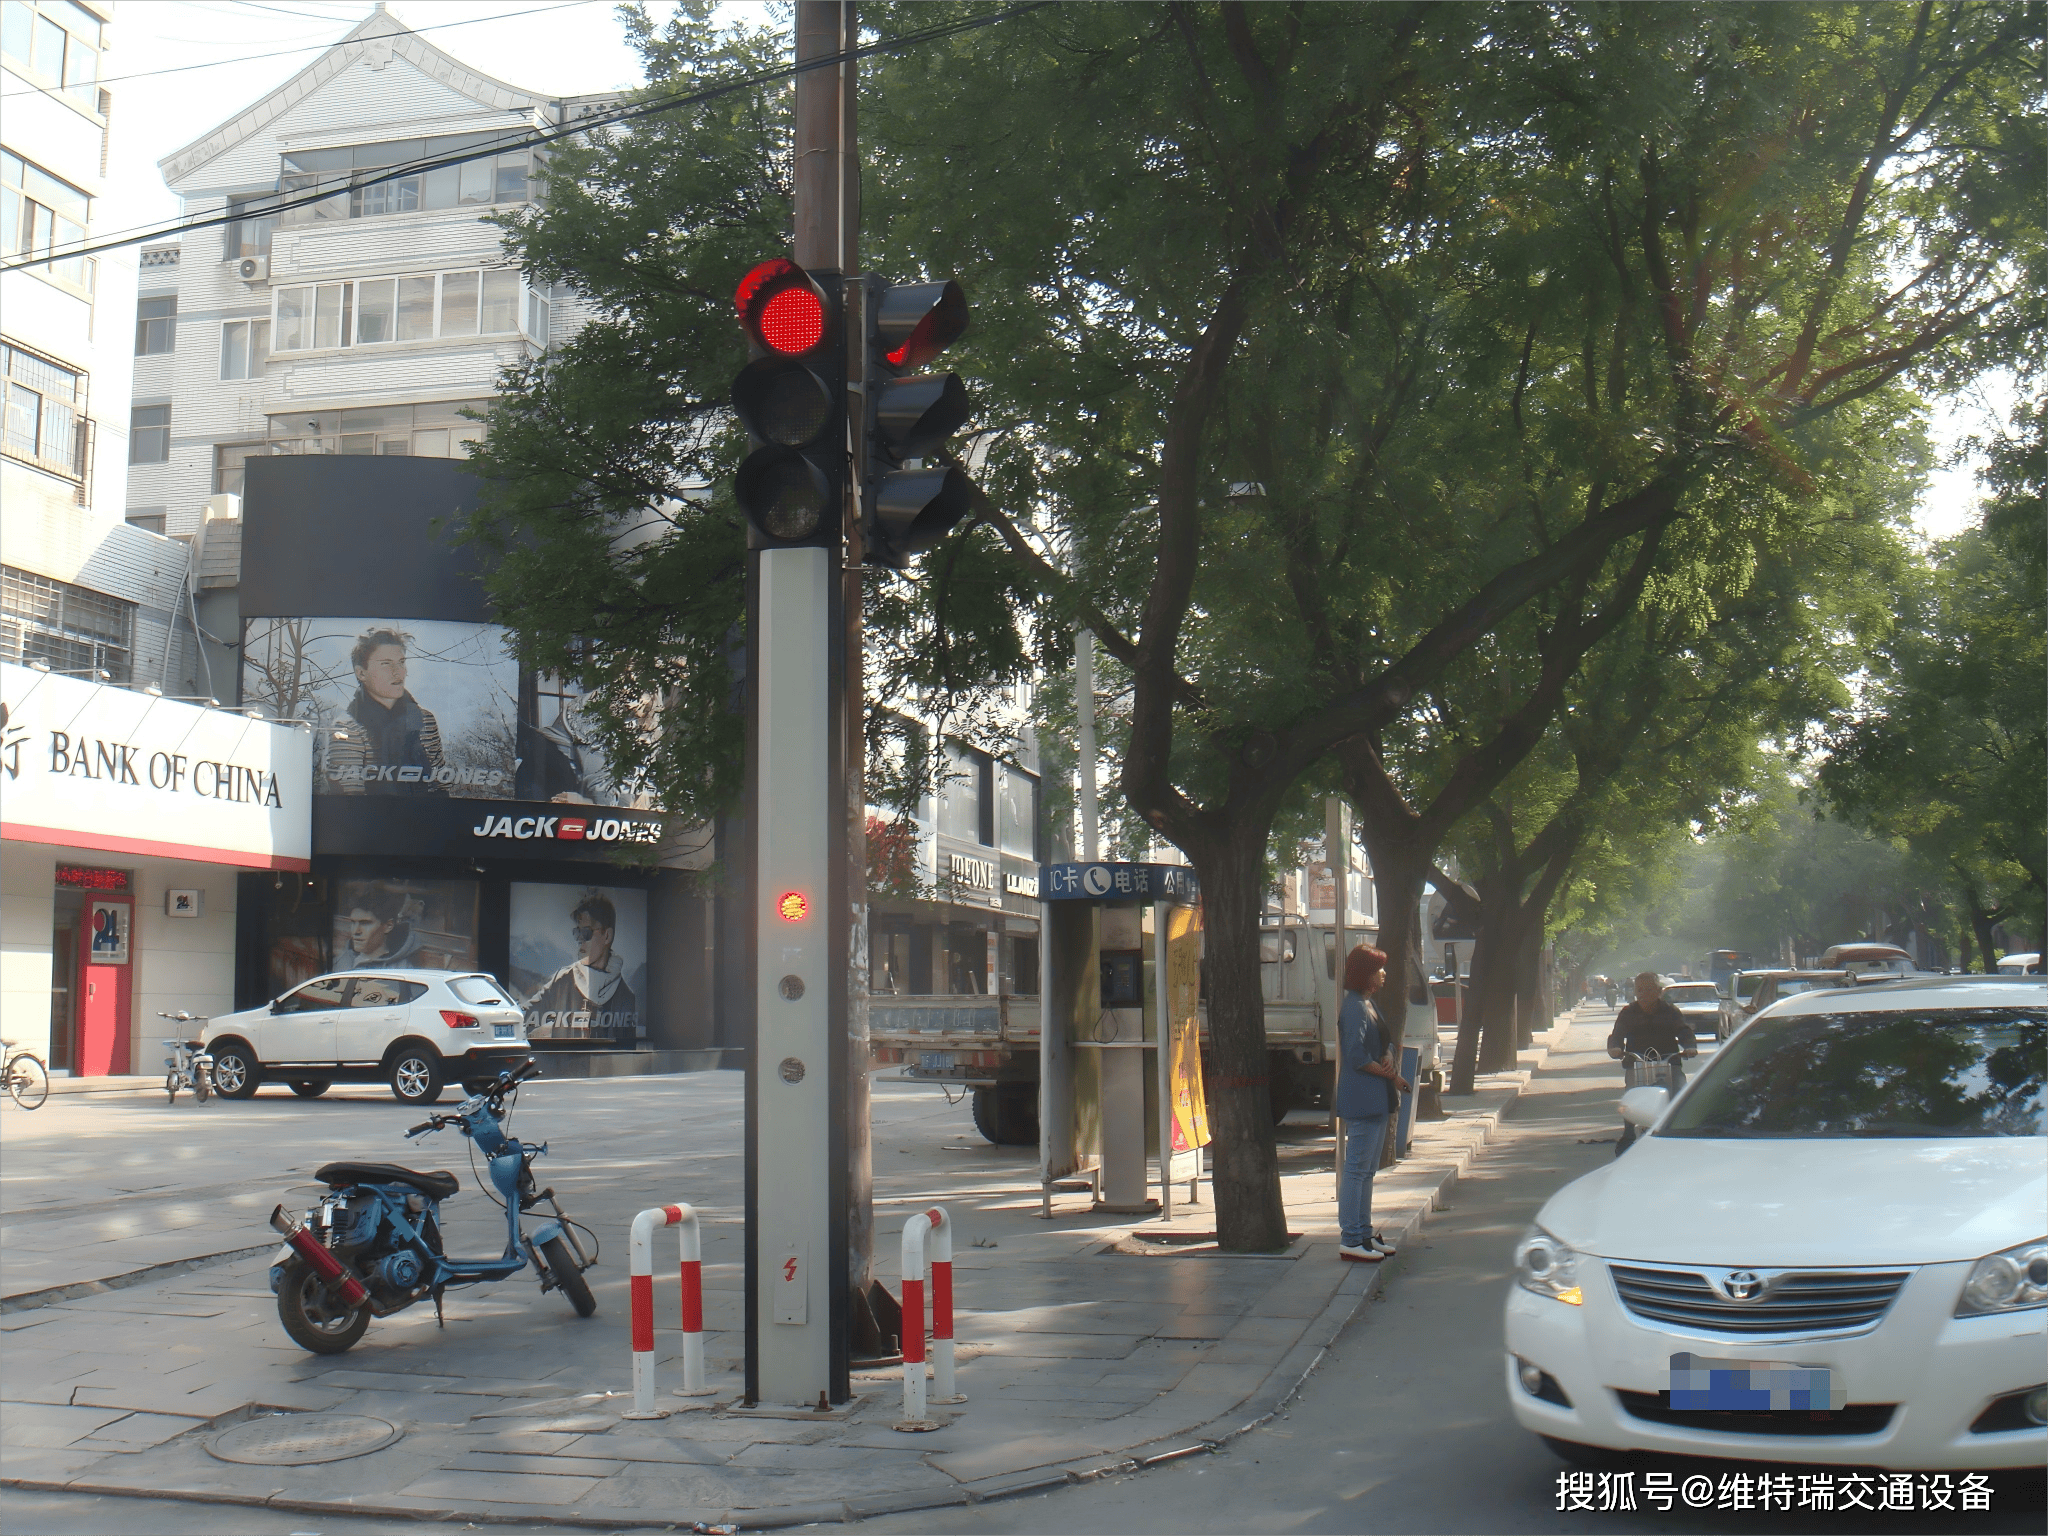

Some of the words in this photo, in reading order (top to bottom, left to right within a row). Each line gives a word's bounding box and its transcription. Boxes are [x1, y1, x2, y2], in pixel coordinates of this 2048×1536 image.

[48, 730, 141, 786] BANK
[149, 751, 188, 793] OF
[193, 760, 283, 809] CHINA
[423, 766, 501, 786] JONES
[473, 815, 559, 839] JACK
[1050, 866, 1079, 893] IC卡
[1115, 868, 1149, 894] 电话
[525, 1010, 572, 1028] ACK
